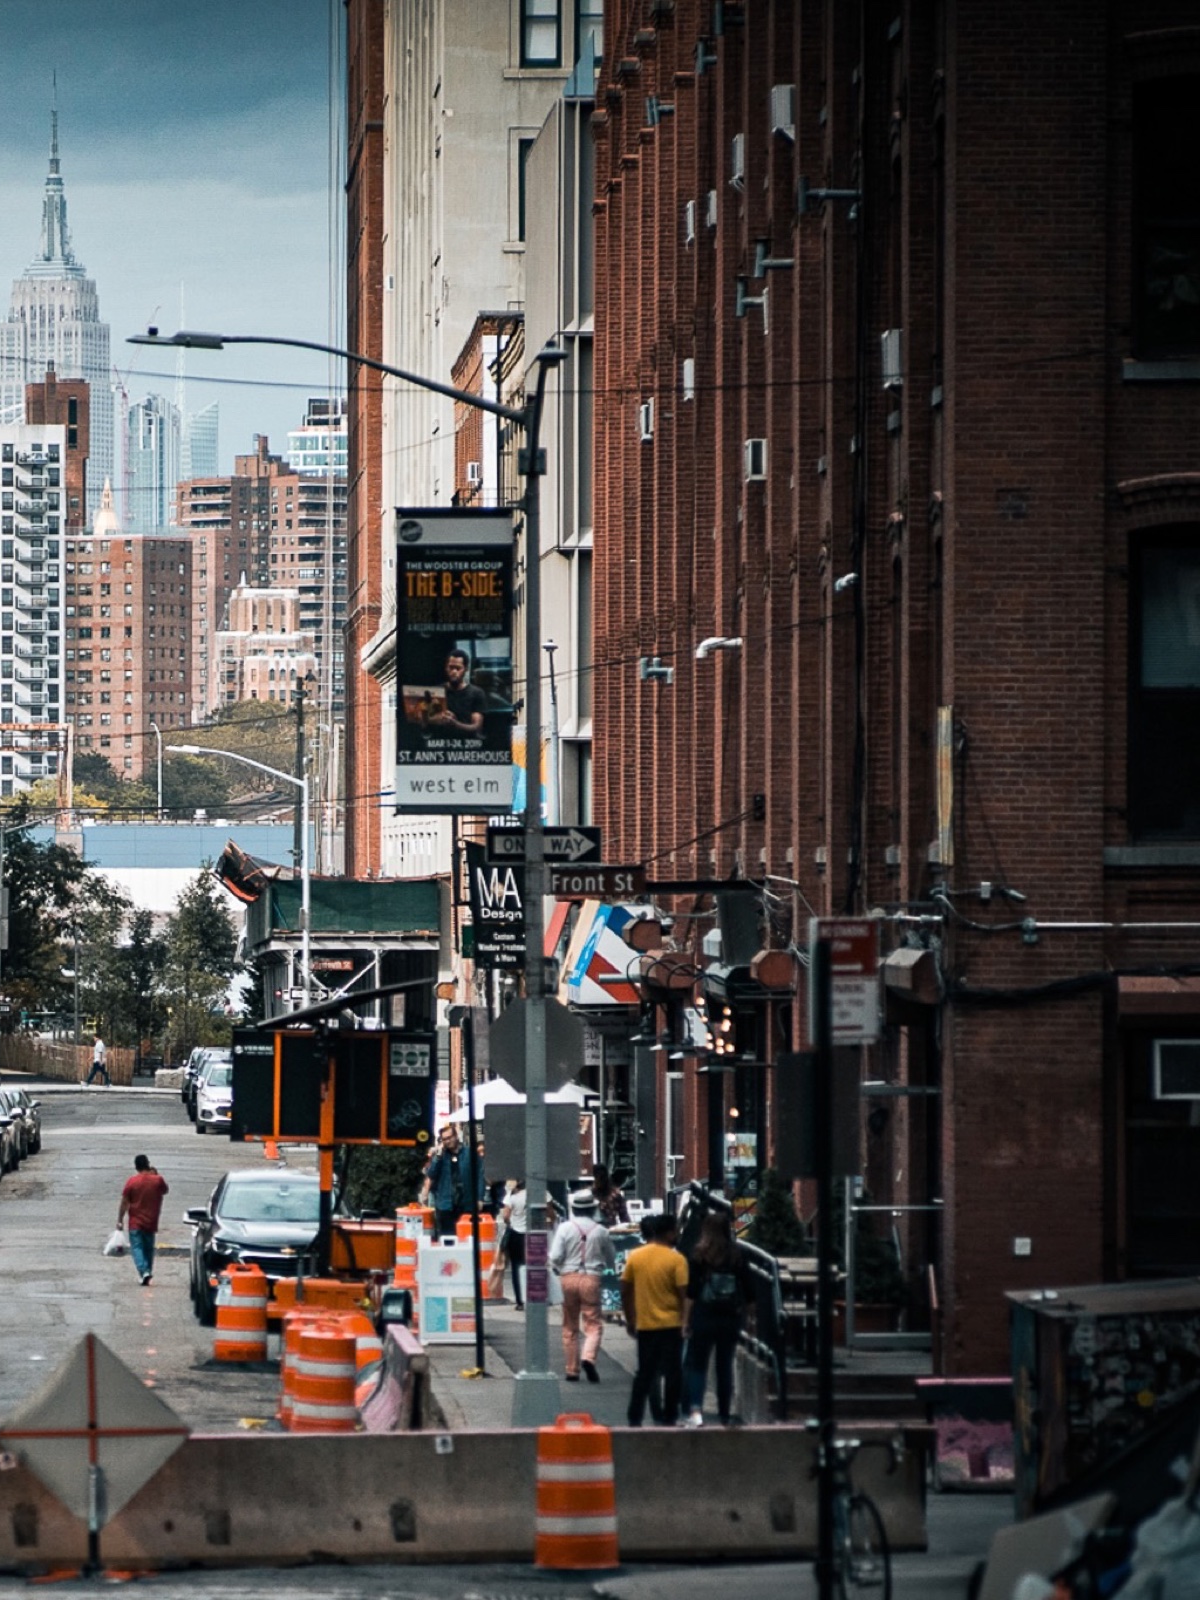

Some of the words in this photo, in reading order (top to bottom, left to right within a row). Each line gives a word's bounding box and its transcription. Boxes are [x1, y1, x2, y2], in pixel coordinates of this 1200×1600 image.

[406, 562, 422, 570] THE
[424, 561, 469, 570] WOOSTER
[470, 561, 503, 570] GROUP
[406, 572, 437, 597] THE
[442, 571, 503, 597] B-SIDE:
[427, 739, 445, 748] MAR
[399, 751, 412, 762] ST.
[414, 751, 445, 762] ANN'S
[447, 751, 511, 762] WAREHOUSE
[410, 777, 455, 793] west
[464, 777, 499, 793] elm
[503, 838, 525, 852] ON
[551, 838, 585, 852] WAY
[476, 867, 522, 908] MA
[552, 874, 605, 891] Front
[614, 873, 634, 891] St
[481, 908, 523, 922] Design
[478, 943, 500, 951] Window
[392, 1050, 428, 1066] DOT
